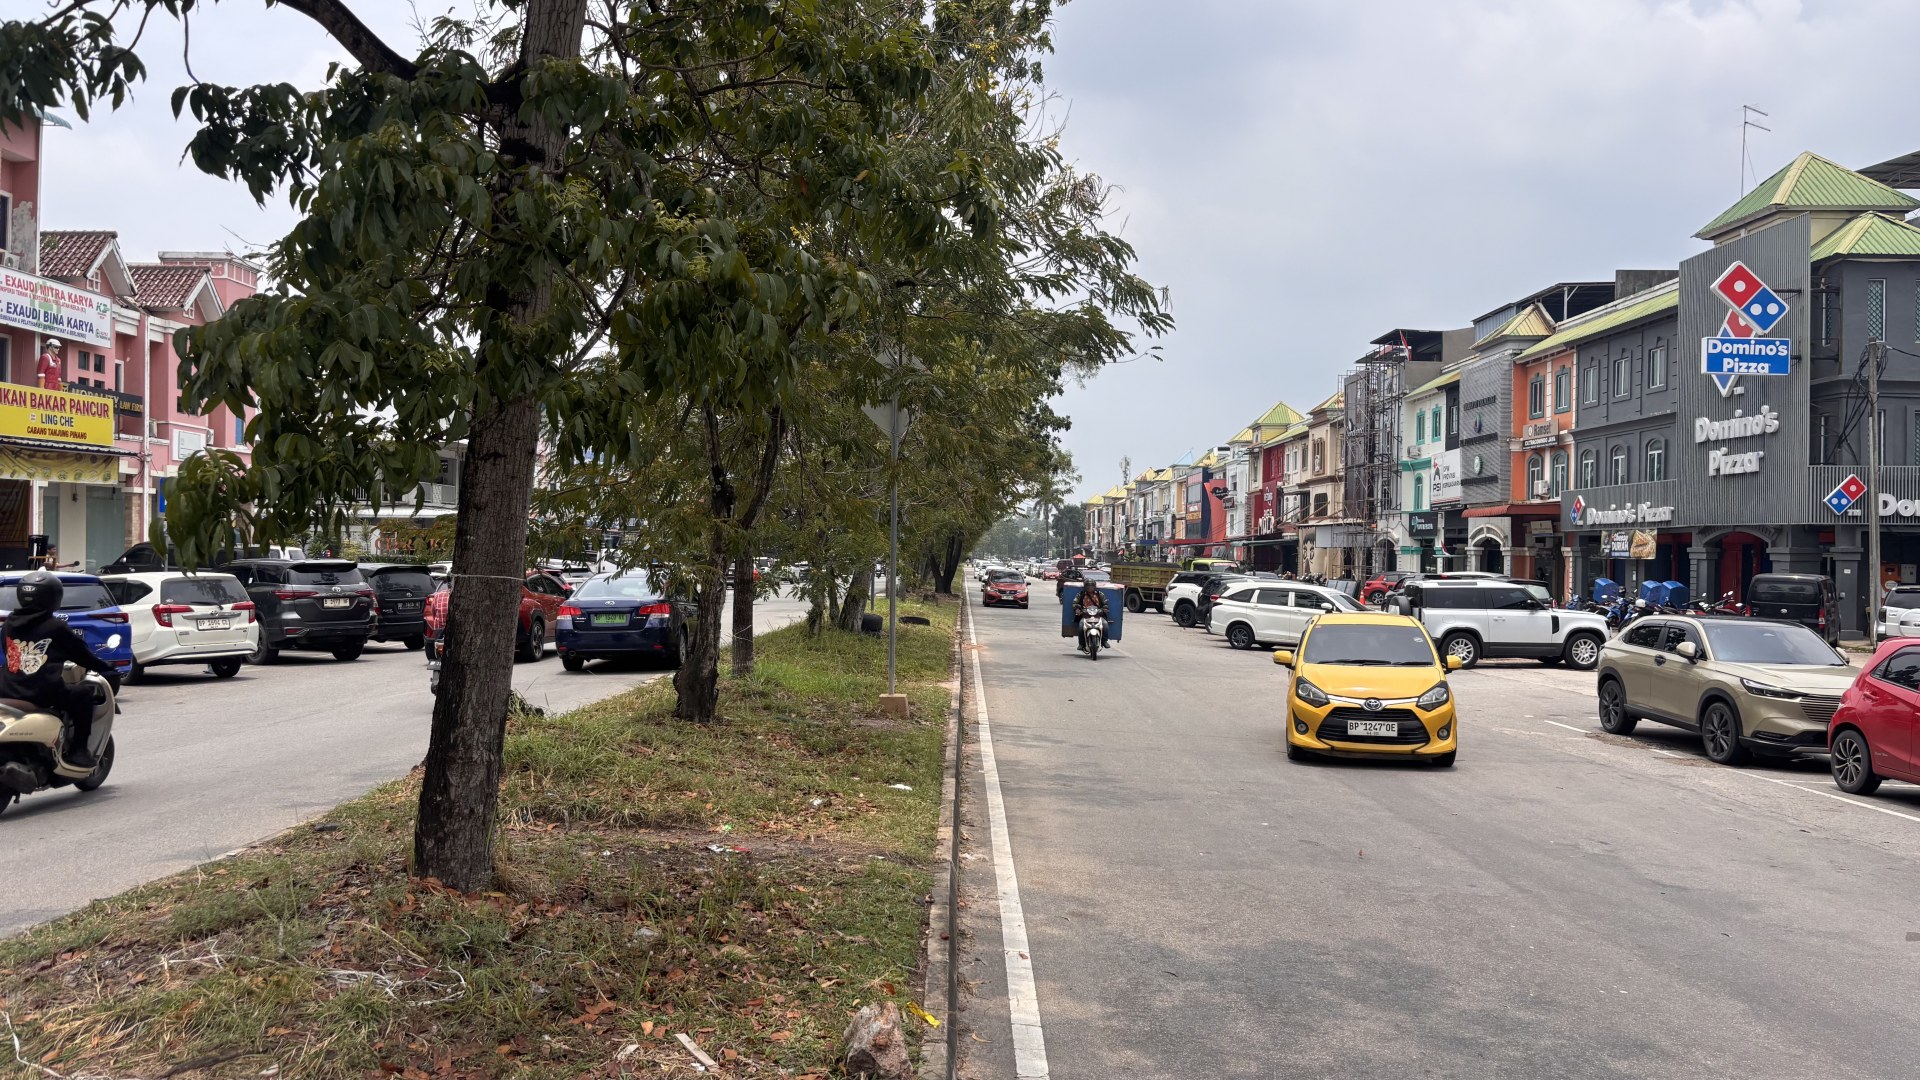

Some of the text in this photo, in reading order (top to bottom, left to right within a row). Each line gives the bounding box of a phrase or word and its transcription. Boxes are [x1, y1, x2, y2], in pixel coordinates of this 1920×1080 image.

[5, 275, 94, 309] EXAUDI MITRA KARYA
[6, 302, 94, 334] EXAUDI BINA KARYA
[1708, 339, 1789, 356] Domino's
[1721, 358, 1767, 374] Pizza
[30, 392, 65, 413] BAKAR
[69, 398, 110, 418] PANCUR
[41, 414, 58, 426] LING
[60, 416, 74, 428] CHE
[1533, 422, 1552, 436] Ramset
[1696, 405, 1780, 443] Domino's
[27, 426, 87, 440] CABANG TANJUNG PINANG
[1708, 447, 1762, 477] Pizza
[1432, 483, 1442, 492] PSI
[1587, 502, 1671, 526] Domino's Pizza
[1349, 721, 1359, 731] BP
[1363, 722, 1383, 732] 1247
